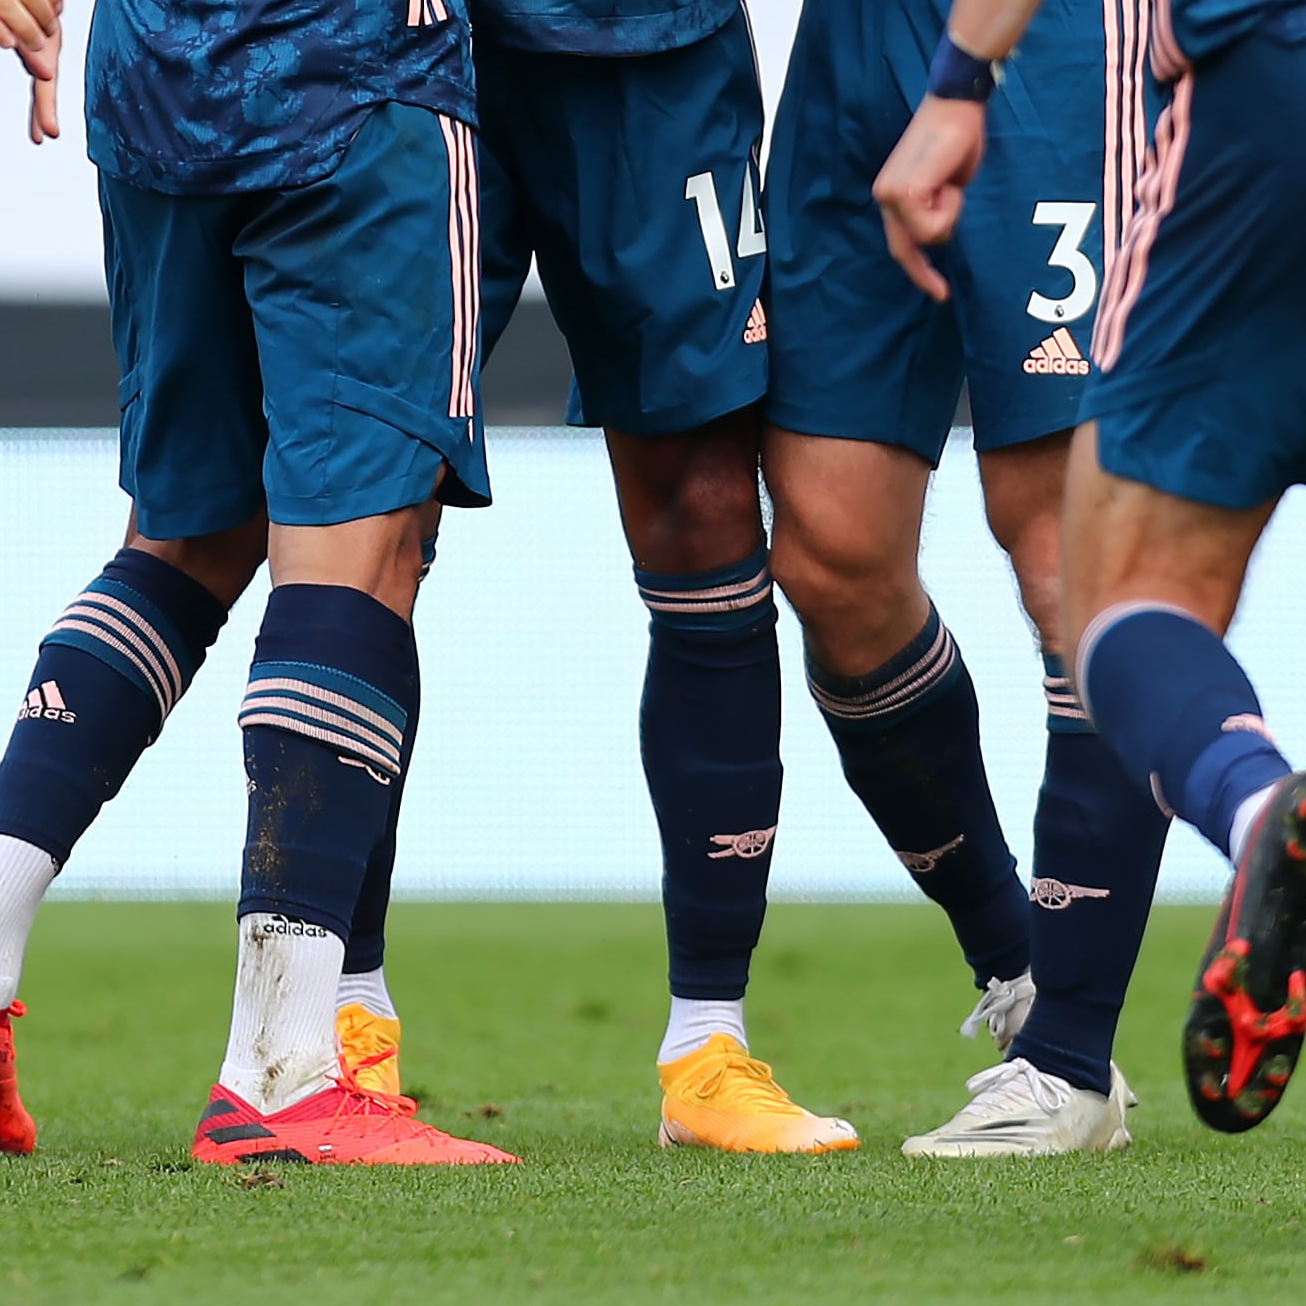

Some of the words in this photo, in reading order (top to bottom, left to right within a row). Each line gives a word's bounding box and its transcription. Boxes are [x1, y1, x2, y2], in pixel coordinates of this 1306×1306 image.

[1026, 201, 1096, 323] 3
[1022, 357, 1090, 375] adidas
[264, 915, 327, 938] adidas
